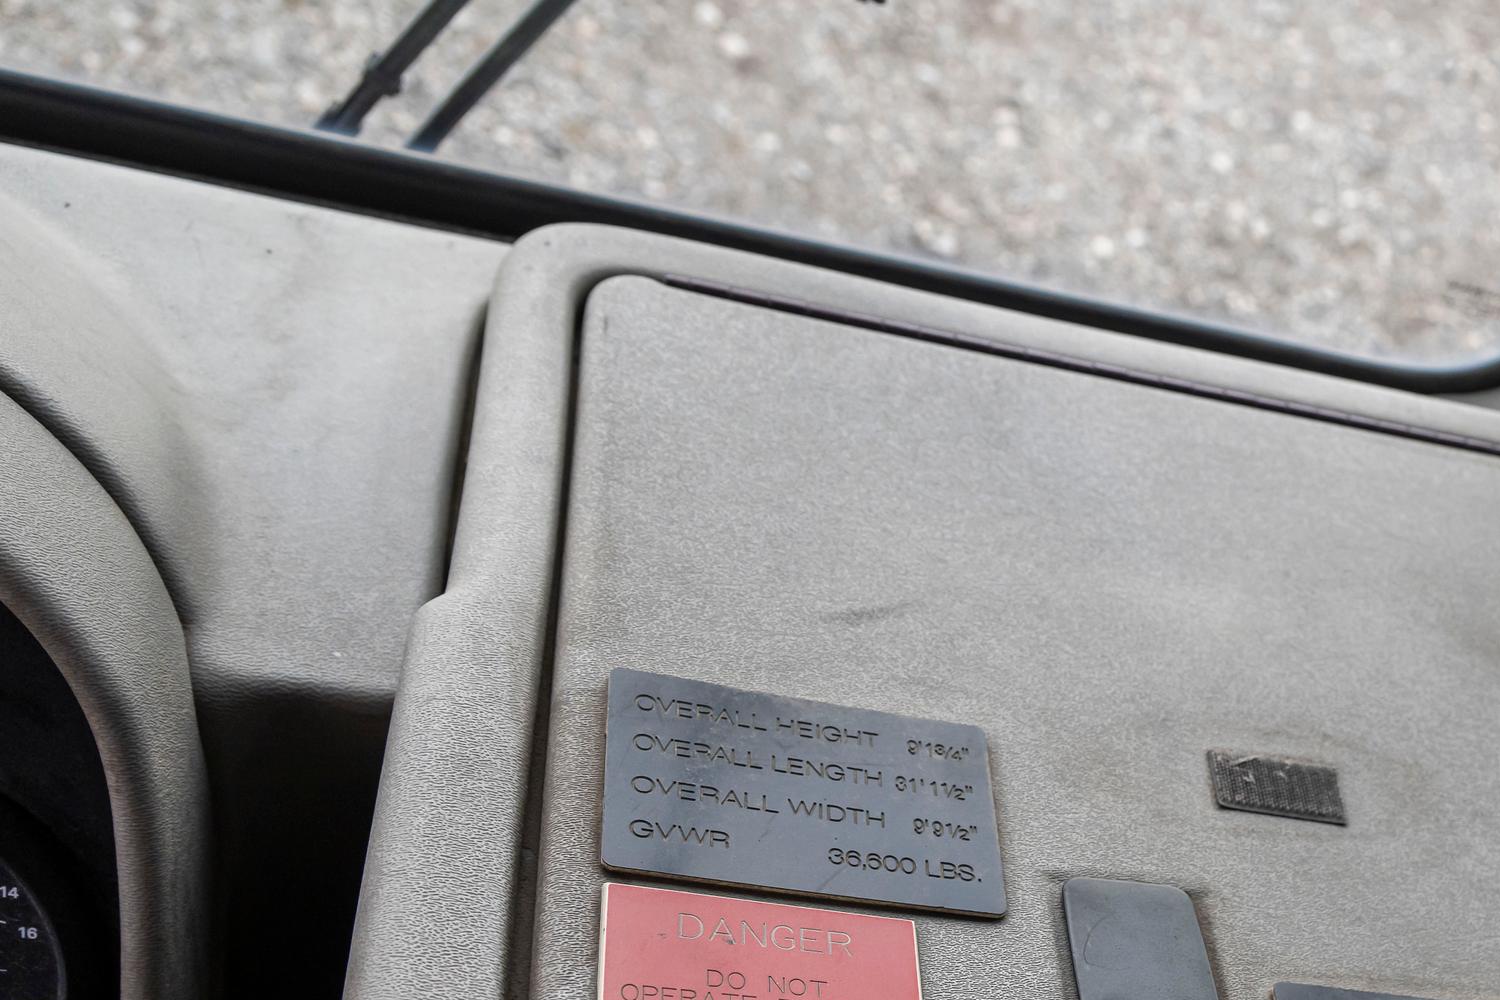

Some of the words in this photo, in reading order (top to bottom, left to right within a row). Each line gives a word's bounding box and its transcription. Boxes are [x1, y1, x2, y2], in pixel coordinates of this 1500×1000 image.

[633, 693, 767, 732] OVERALL
[775, 716, 879, 749] HEIGHT
[632, 733, 763, 770] OVERALL
[771, 754, 883, 788] LENGTH
[630, 774, 779, 815] OVERALL
[787, 797, 886, 829] WIDTH
[628, 818, 731, 849] GVWR
[827, 846, 917, 875] 36,600
[925, 859, 983, 883] LBS.
[0, 886, 19, 900] 14
[18, 926, 38, 940] 16
[676, 911, 853, 957] DANGER
[706, 968, 746, 991] DO
[767, 975, 828, 998] NOT
